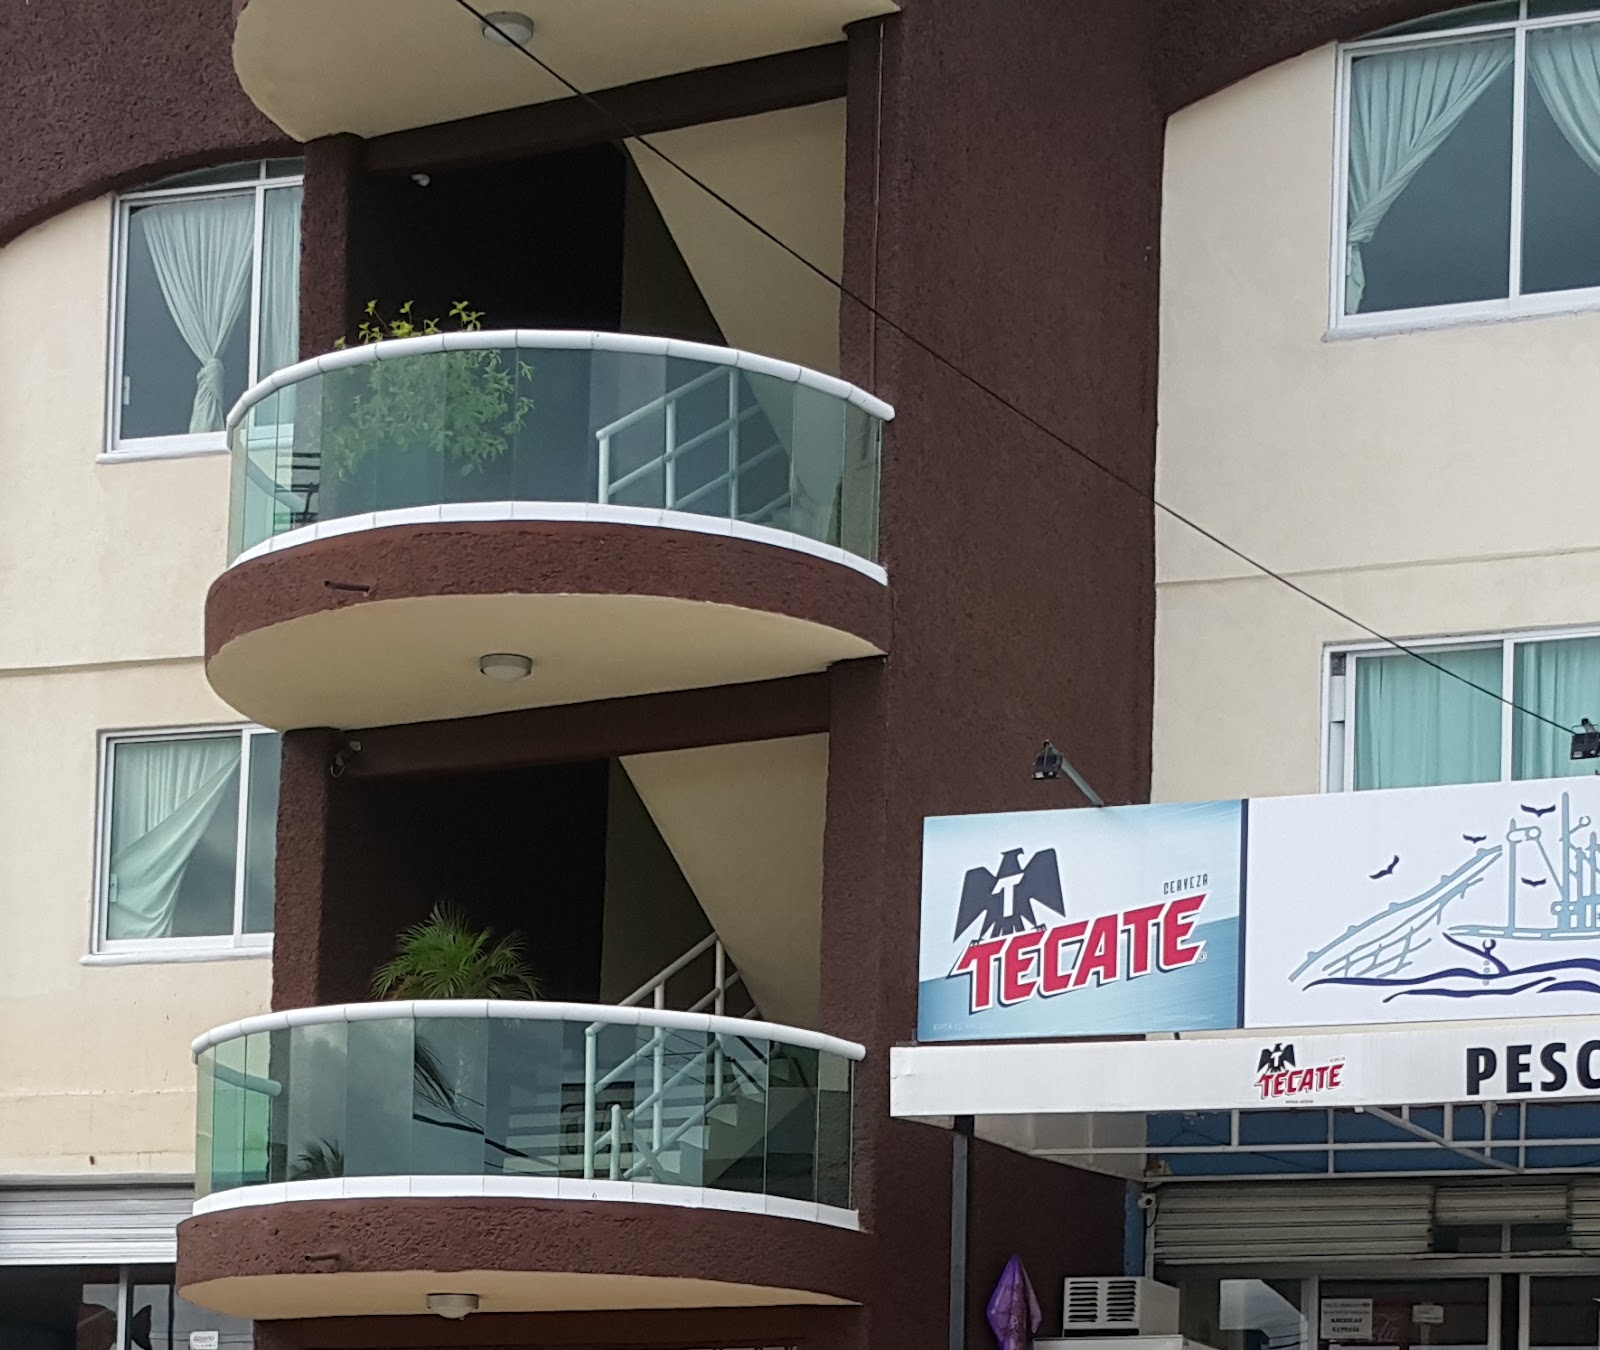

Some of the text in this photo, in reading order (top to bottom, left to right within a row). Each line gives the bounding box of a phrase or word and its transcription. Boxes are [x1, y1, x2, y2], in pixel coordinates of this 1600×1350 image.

[1163, 873, 1209, 895] CERVEZA
[947, 893, 1208, 1014] TECATE
[1254, 1064, 1344, 1099] TECATE
